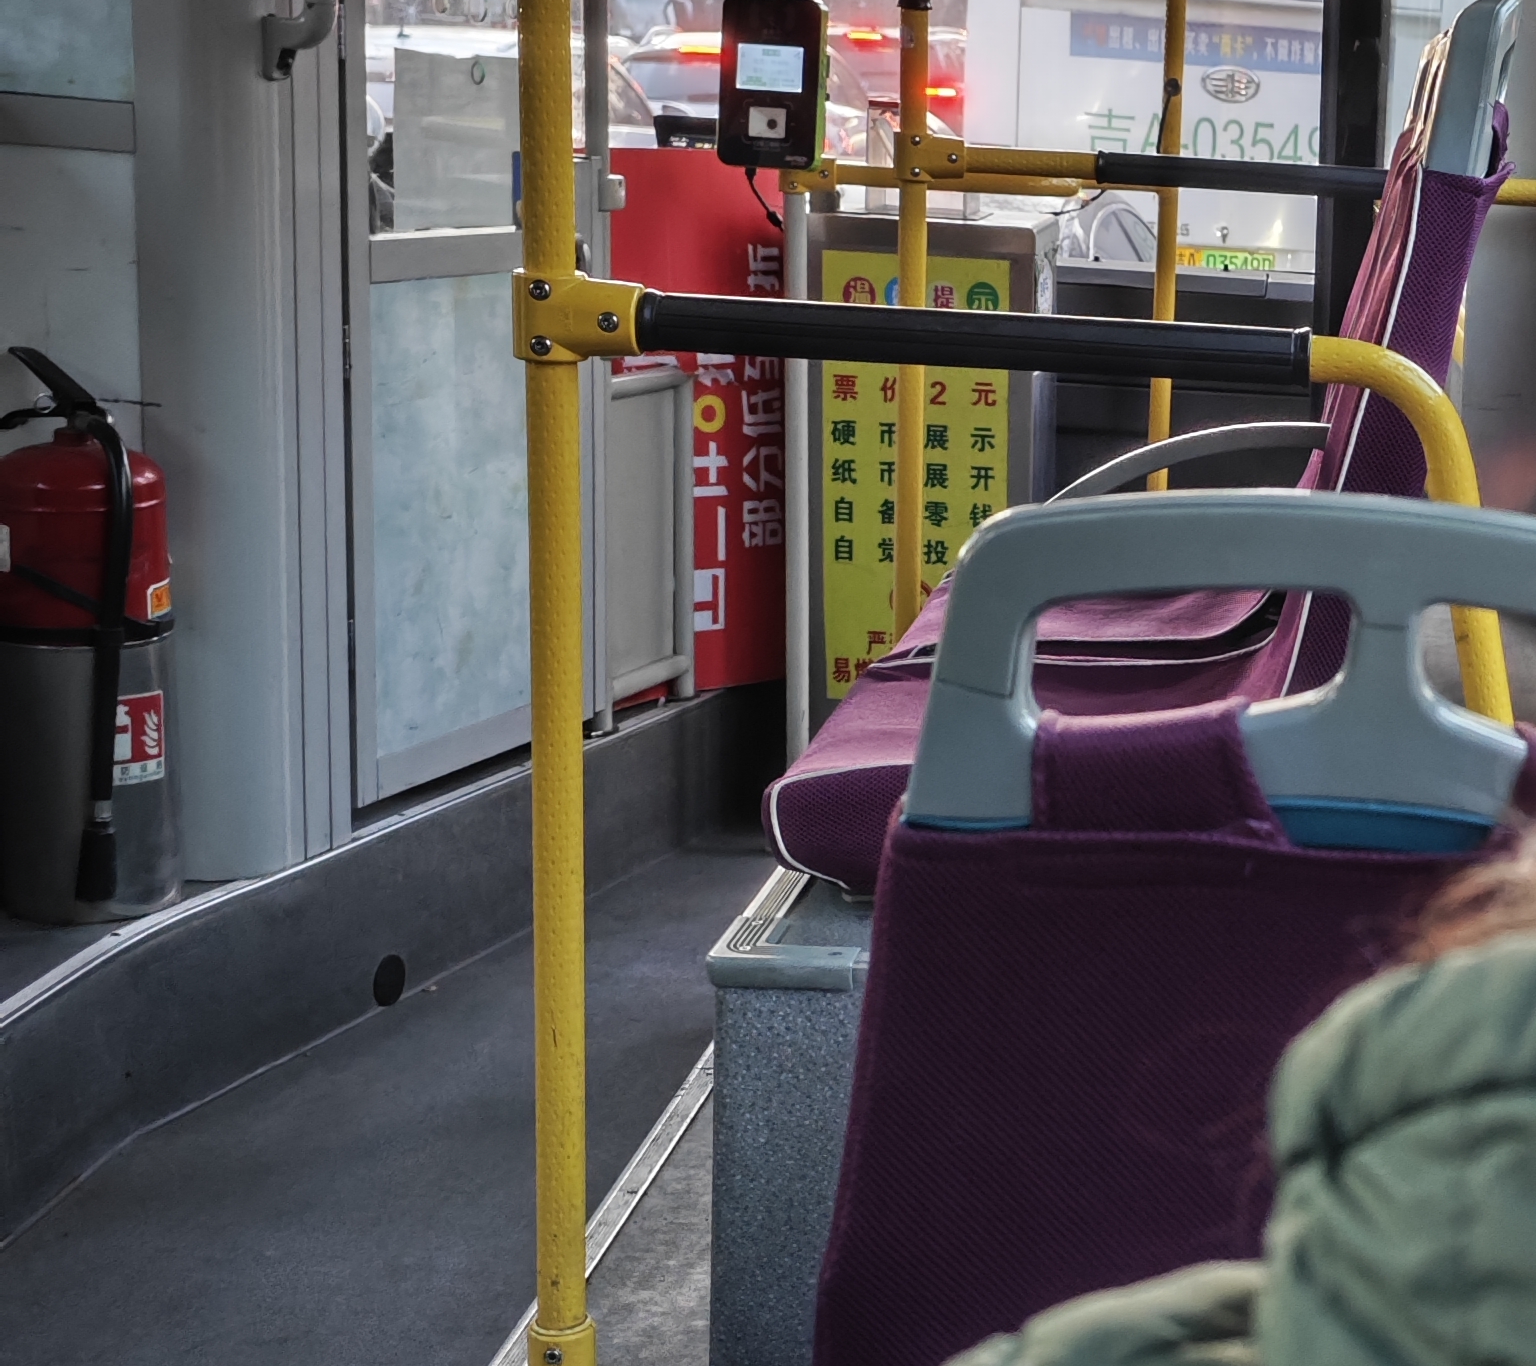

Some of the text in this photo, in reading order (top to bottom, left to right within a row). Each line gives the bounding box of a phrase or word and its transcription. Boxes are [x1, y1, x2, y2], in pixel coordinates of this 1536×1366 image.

[844, 277, 998, 311] 温提示
[833, 535, 950, 566] 自觉投
